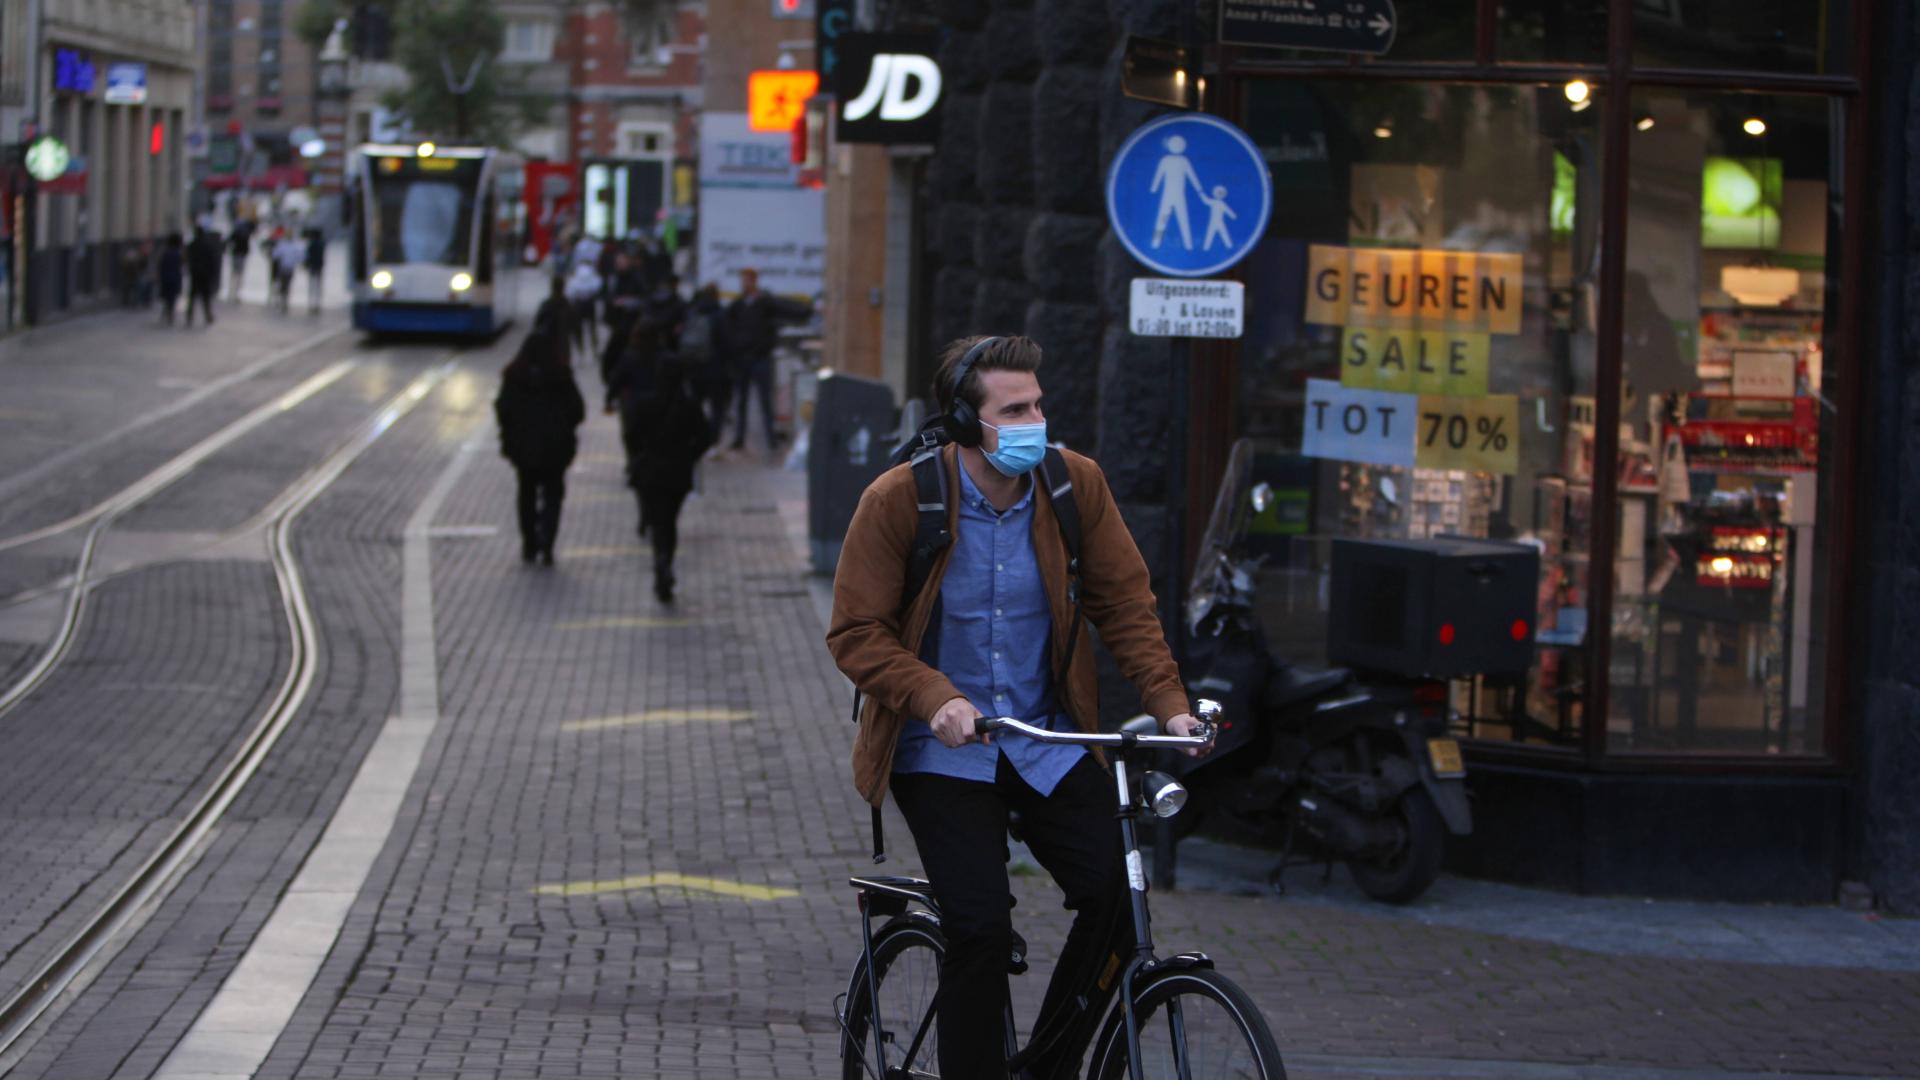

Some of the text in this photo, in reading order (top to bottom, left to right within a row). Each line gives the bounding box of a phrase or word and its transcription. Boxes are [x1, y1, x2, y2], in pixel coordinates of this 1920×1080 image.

[1226, 8, 1257, 20] Anne
[1261, 10, 1324, 26] Frankhuis
[843, 53, 942, 121] JD
[1316, 268, 1506, 310] GEUREN
[1347, 333, 1468, 375] SALE
[1311, 401, 1508, 451] TOT 70%
